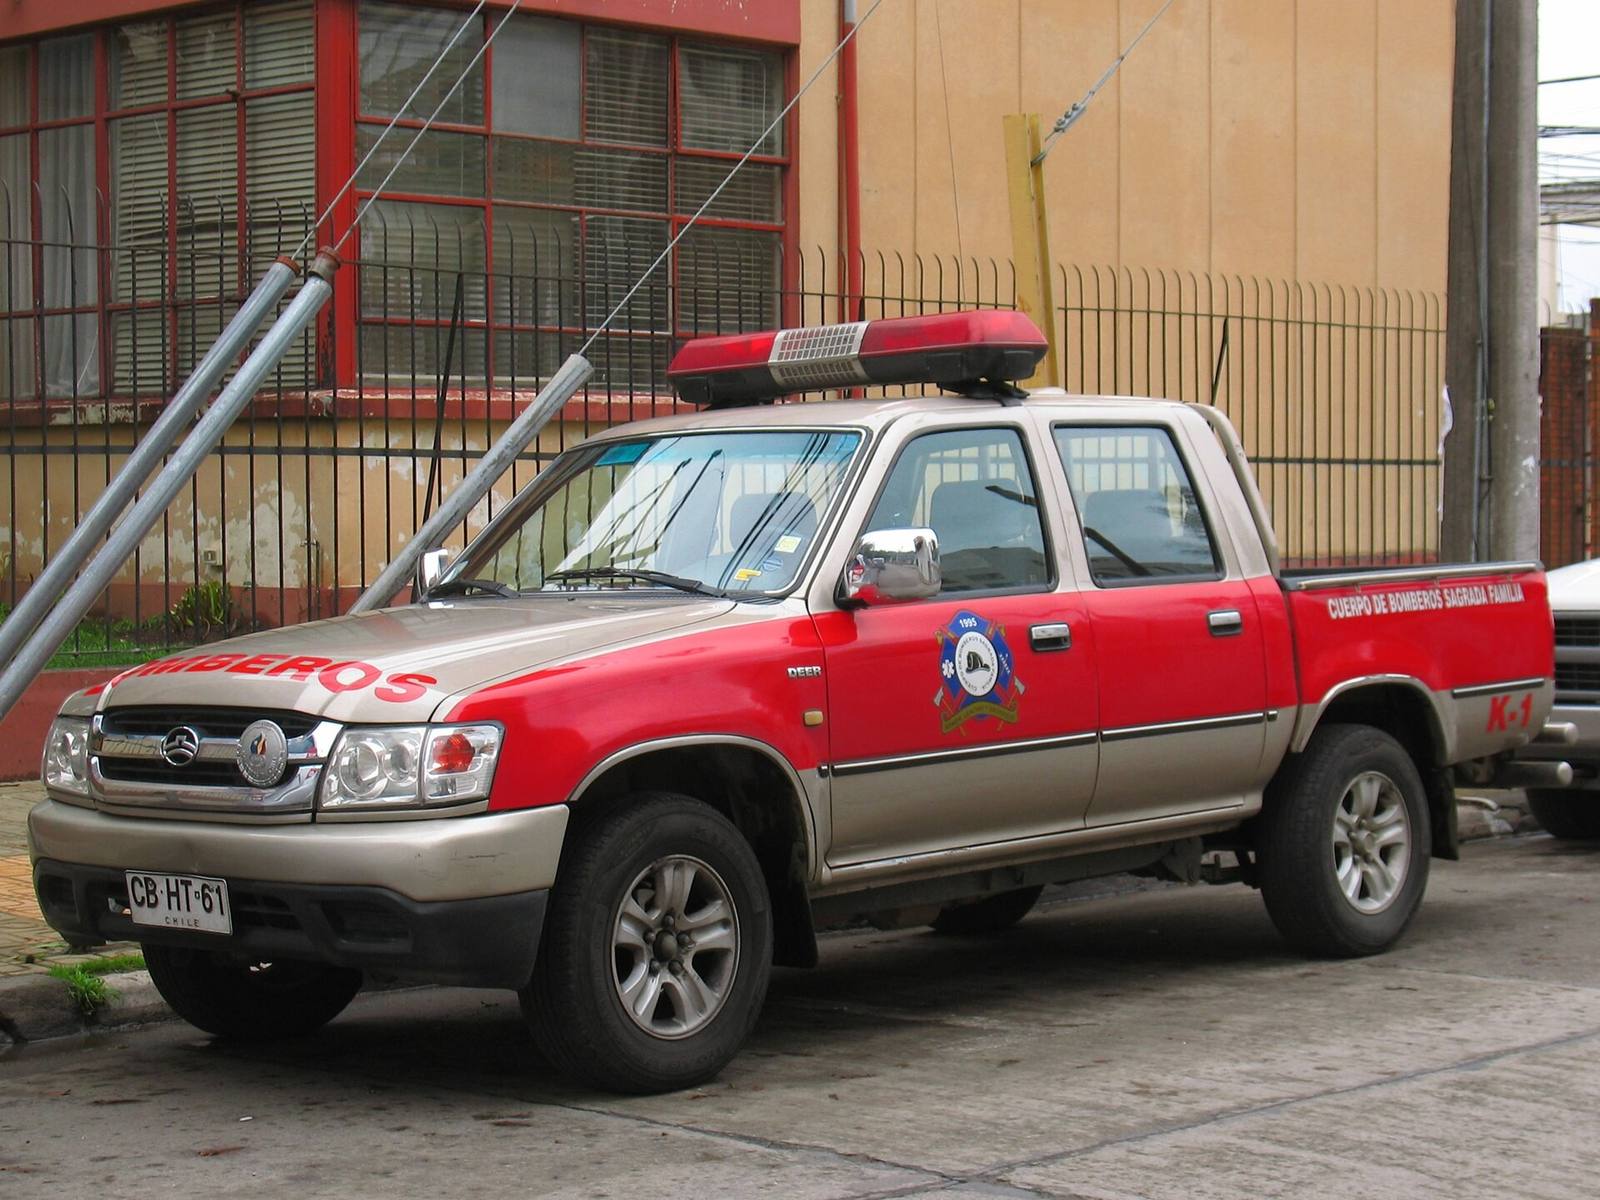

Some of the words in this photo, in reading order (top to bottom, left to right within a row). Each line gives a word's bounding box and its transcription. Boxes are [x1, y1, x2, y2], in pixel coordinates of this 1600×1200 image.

[1328, 595, 1372, 619] CUERPO
[1372, 593, 1389, 614] DE
[1388, 588, 1443, 613] BOMBEROS
[1443, 585, 1488, 608] SAGRADA
[1487, 582, 1525, 604] FAMILIA
[959, 617, 977, 628] 1995
[84, 653, 437, 703] MBEROS
[787, 665, 822, 678] DEER
[1486, 693, 1533, 733] K-1
[164, 916, 200, 928] CHILE
